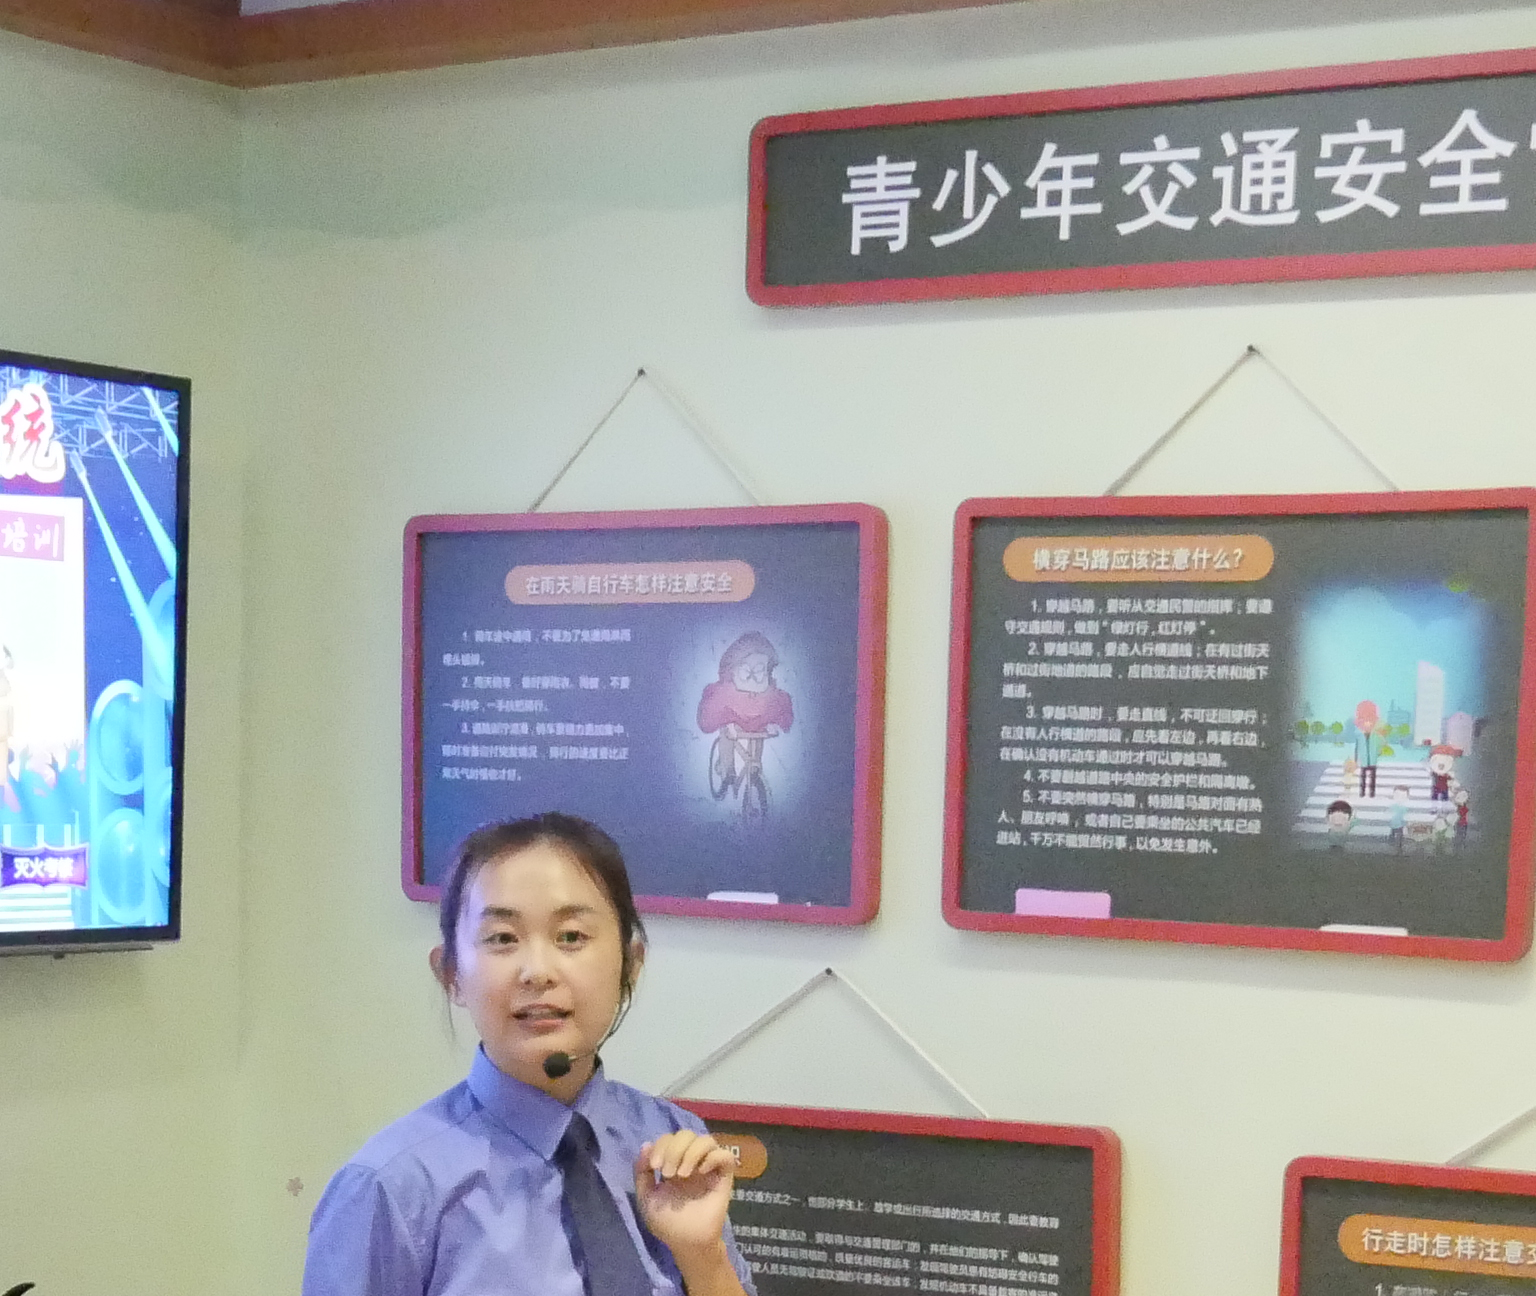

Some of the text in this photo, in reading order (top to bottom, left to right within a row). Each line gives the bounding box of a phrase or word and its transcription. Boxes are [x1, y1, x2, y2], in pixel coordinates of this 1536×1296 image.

[1032, 548, 1245, 572] 横穿马路应该注意什么?
[525, 573, 733, 596] 在雨天骑自行车怎样注意安全
